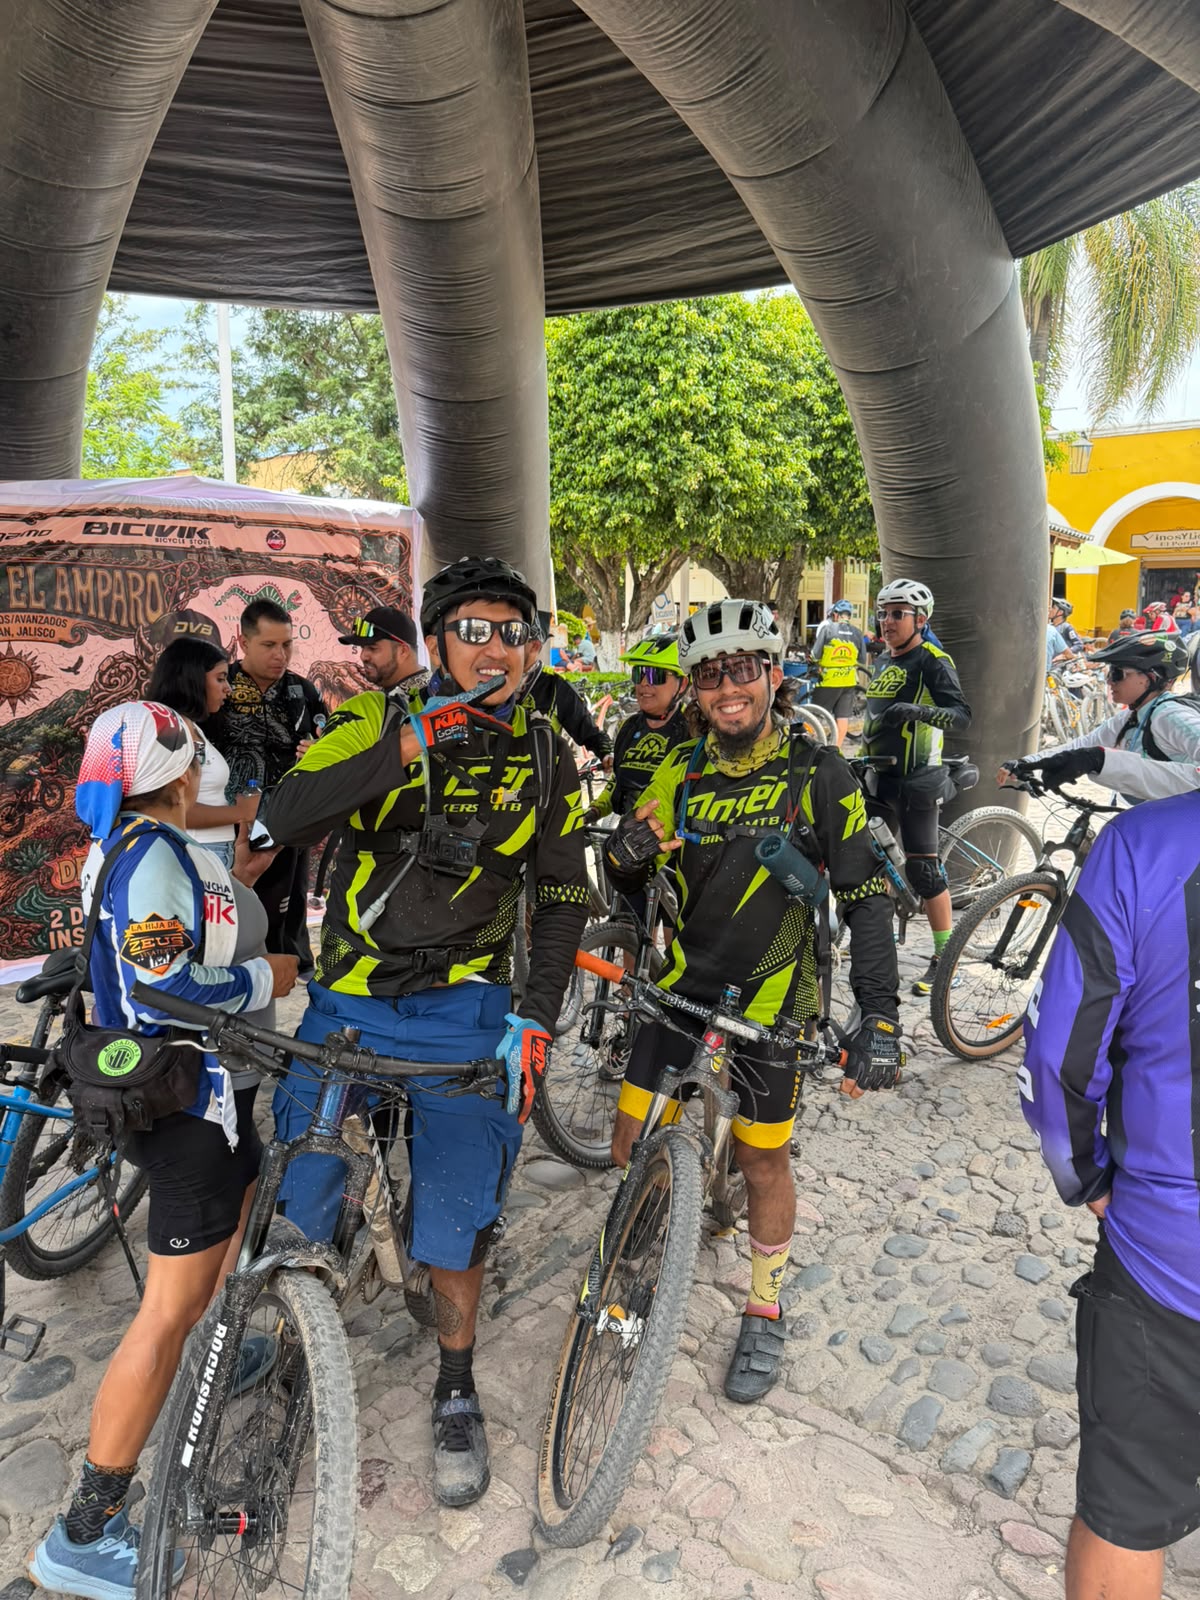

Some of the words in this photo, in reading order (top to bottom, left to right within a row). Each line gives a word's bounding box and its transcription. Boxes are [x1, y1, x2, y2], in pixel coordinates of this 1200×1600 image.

[82, 522, 212, 540] BICIVIK
[155, 537, 185, 545] BICYCLE
[7, 565, 46, 609] EL
[54, 566, 164, 629] AMPARO
[16, 628, 55, 639] JALISCO
[174, 621, 213, 636] DVB
[434, 711, 468, 731] KTM
[436, 724, 469, 739] GoPro
[131, 924, 143, 932] LA
[145, 921, 165, 930] HIJA
[129, 936, 184, 955] ZEUS
[187, 1322, 228, 1442] ROCKSHOX
